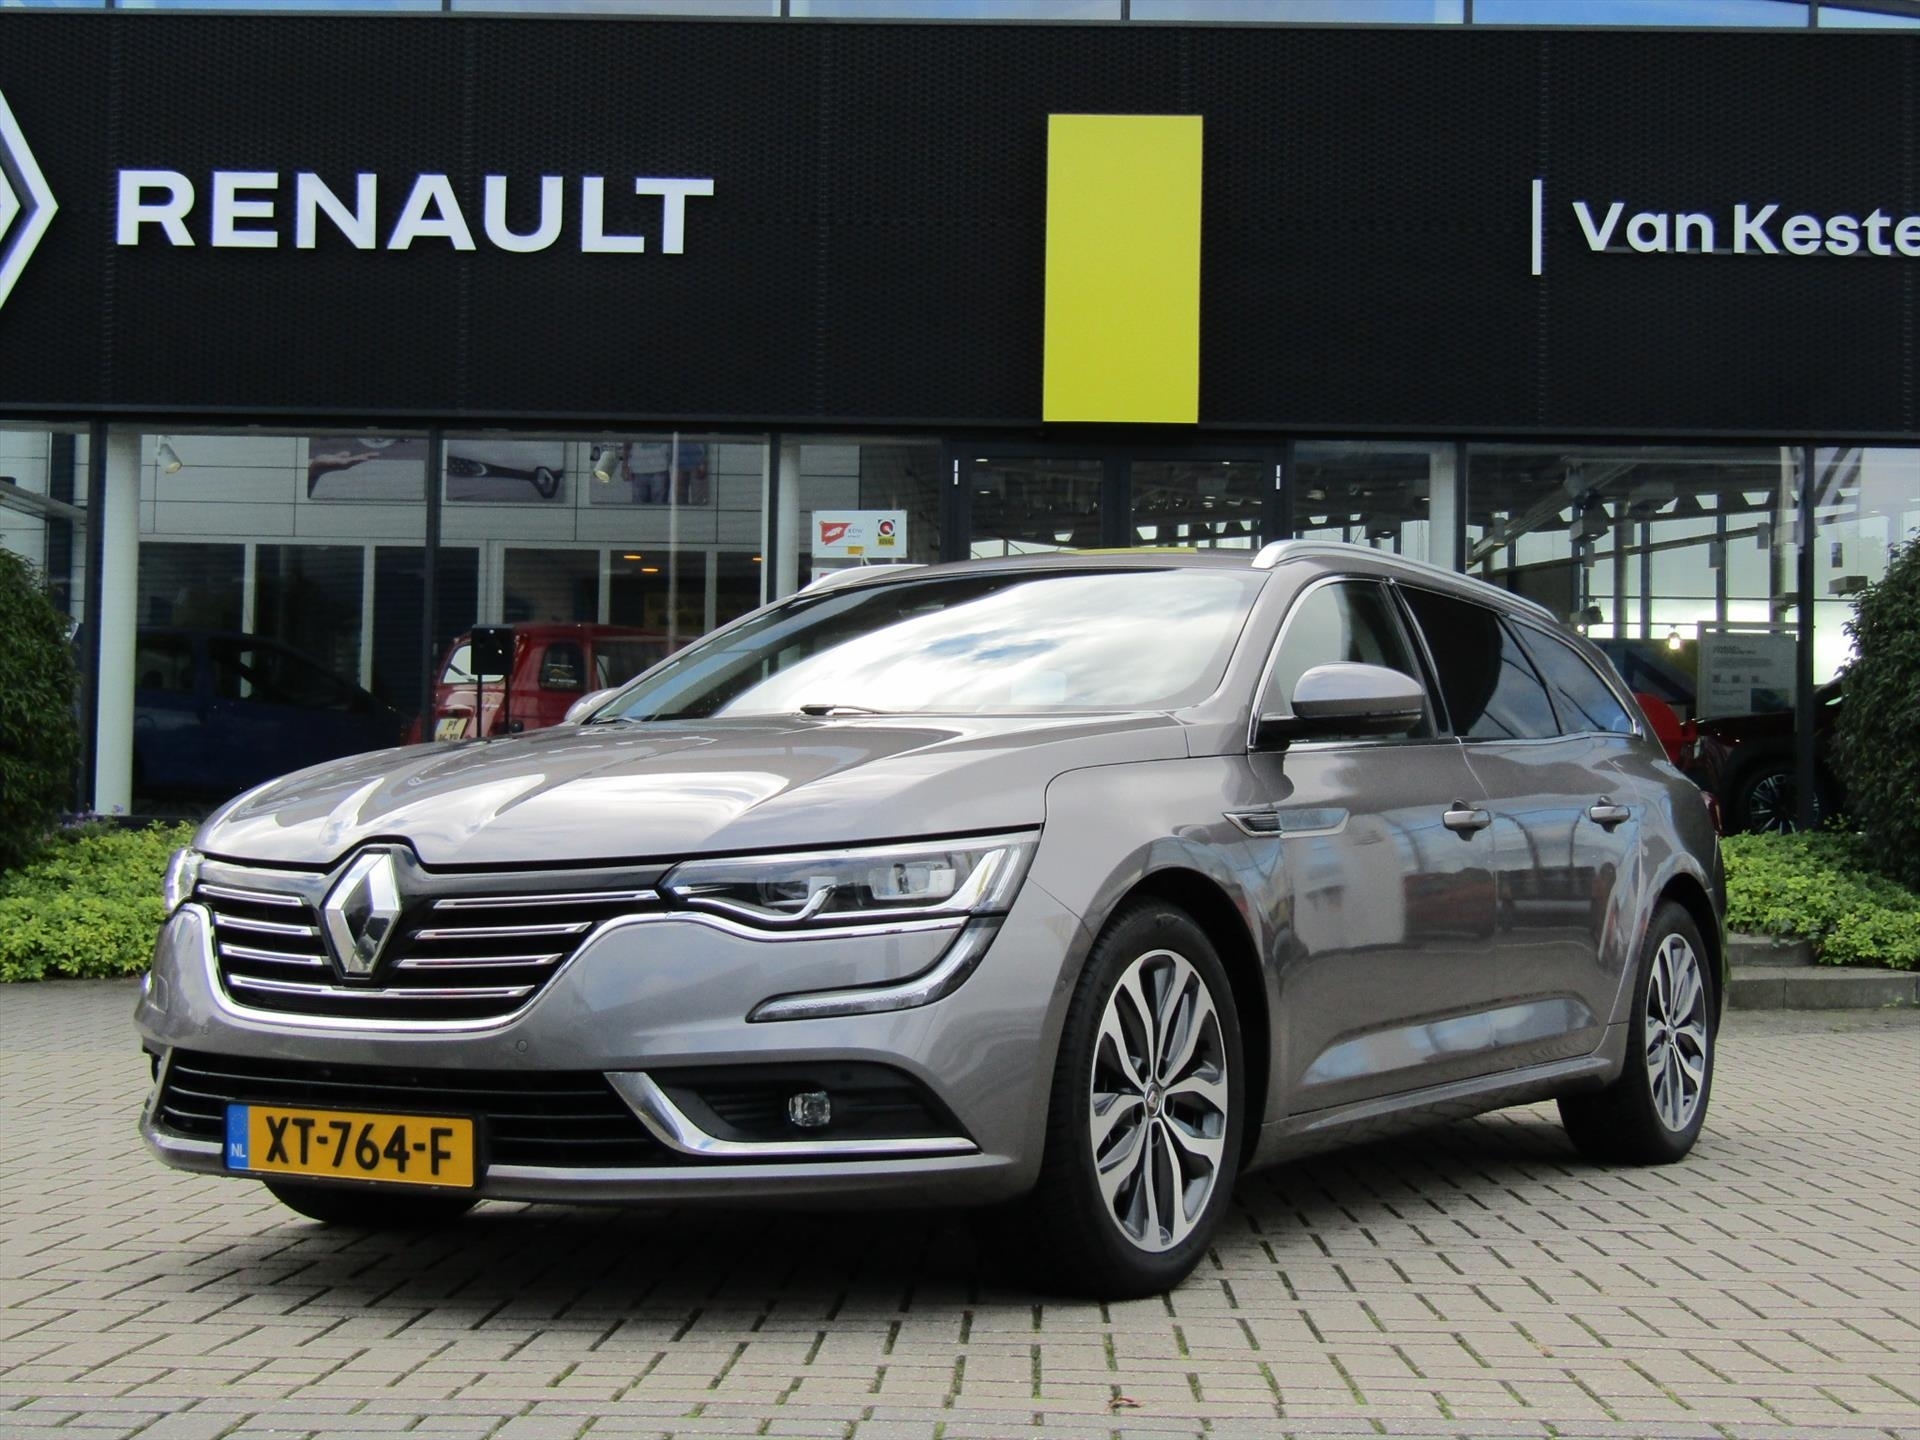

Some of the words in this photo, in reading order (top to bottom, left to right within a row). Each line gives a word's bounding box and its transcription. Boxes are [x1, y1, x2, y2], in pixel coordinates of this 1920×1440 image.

[116, 169, 715, 255] RENAULT
[1572, 201, 1715, 254] Van
[1733, 203, 1920, 257] Keste
[231, 1143, 247, 1159] NL
[265, 1116, 453, 1176] XT-764-F
